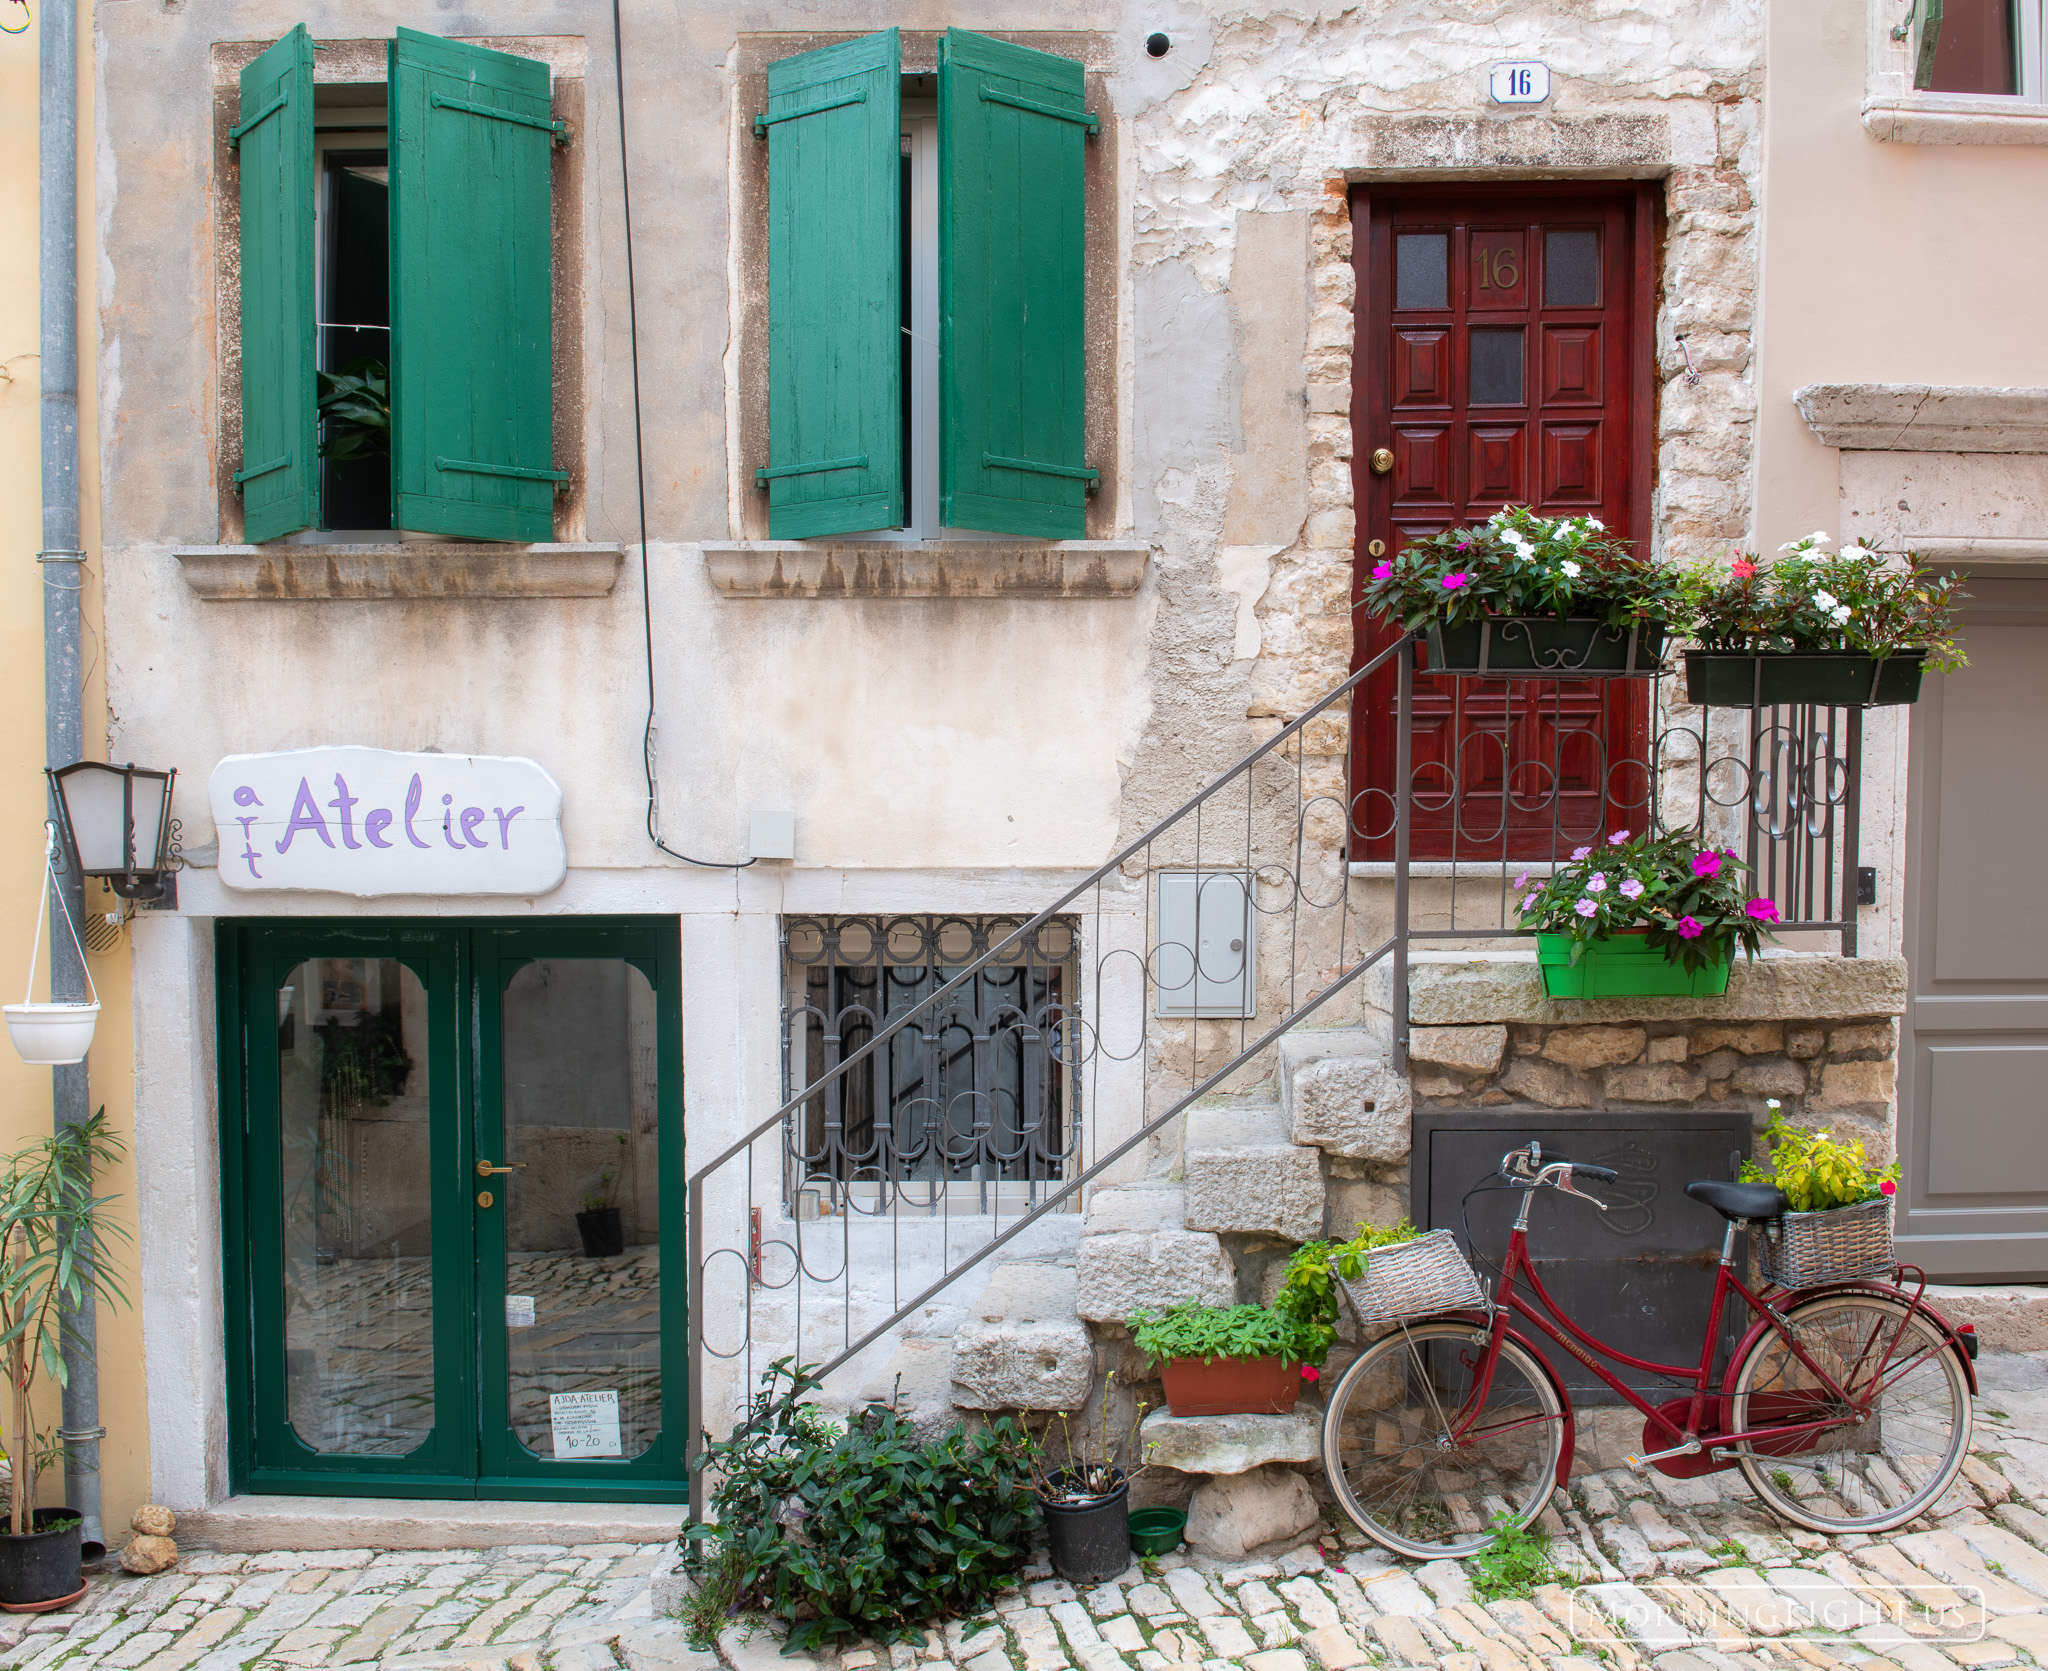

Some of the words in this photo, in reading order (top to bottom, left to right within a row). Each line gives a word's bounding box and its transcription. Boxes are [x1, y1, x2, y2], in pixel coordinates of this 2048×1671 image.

[1509, 69, 1531, 96] 16
[1475, 248, 1519, 290] 16
[233, 786, 264, 878] art
[275, 772, 525, 855] Atelier
